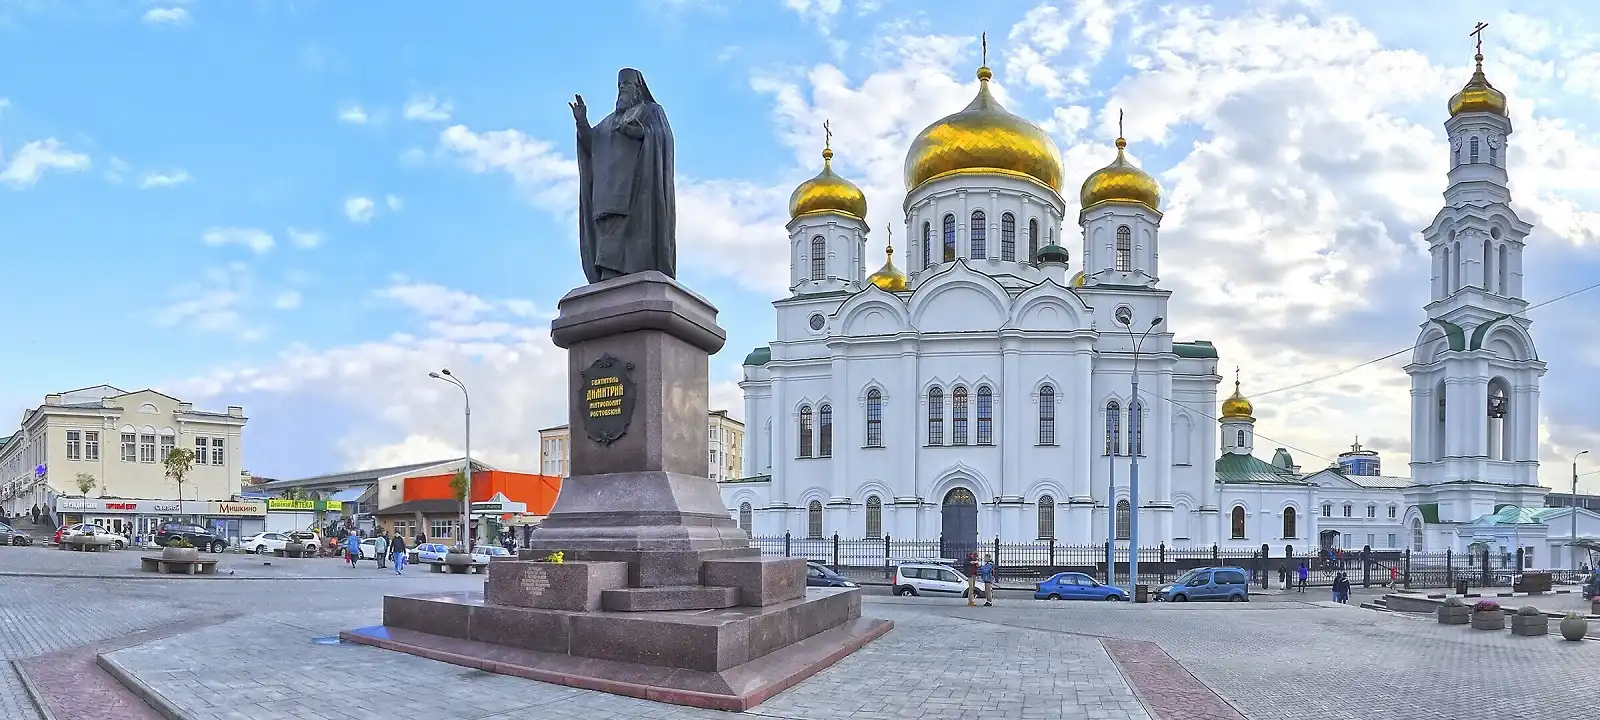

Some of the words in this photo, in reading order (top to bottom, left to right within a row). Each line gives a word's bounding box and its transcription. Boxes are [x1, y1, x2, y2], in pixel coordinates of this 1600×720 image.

[586, 383, 624, 401] ДИМИТРИЙ
[589, 399, 622, 409] МИТРОПОЛИТ
[589, 407, 622, 418] РОСТОВСКИЙ
[219, 502, 257, 514] Мишкино
[291, 501, 313, 509] АПТЕКА
